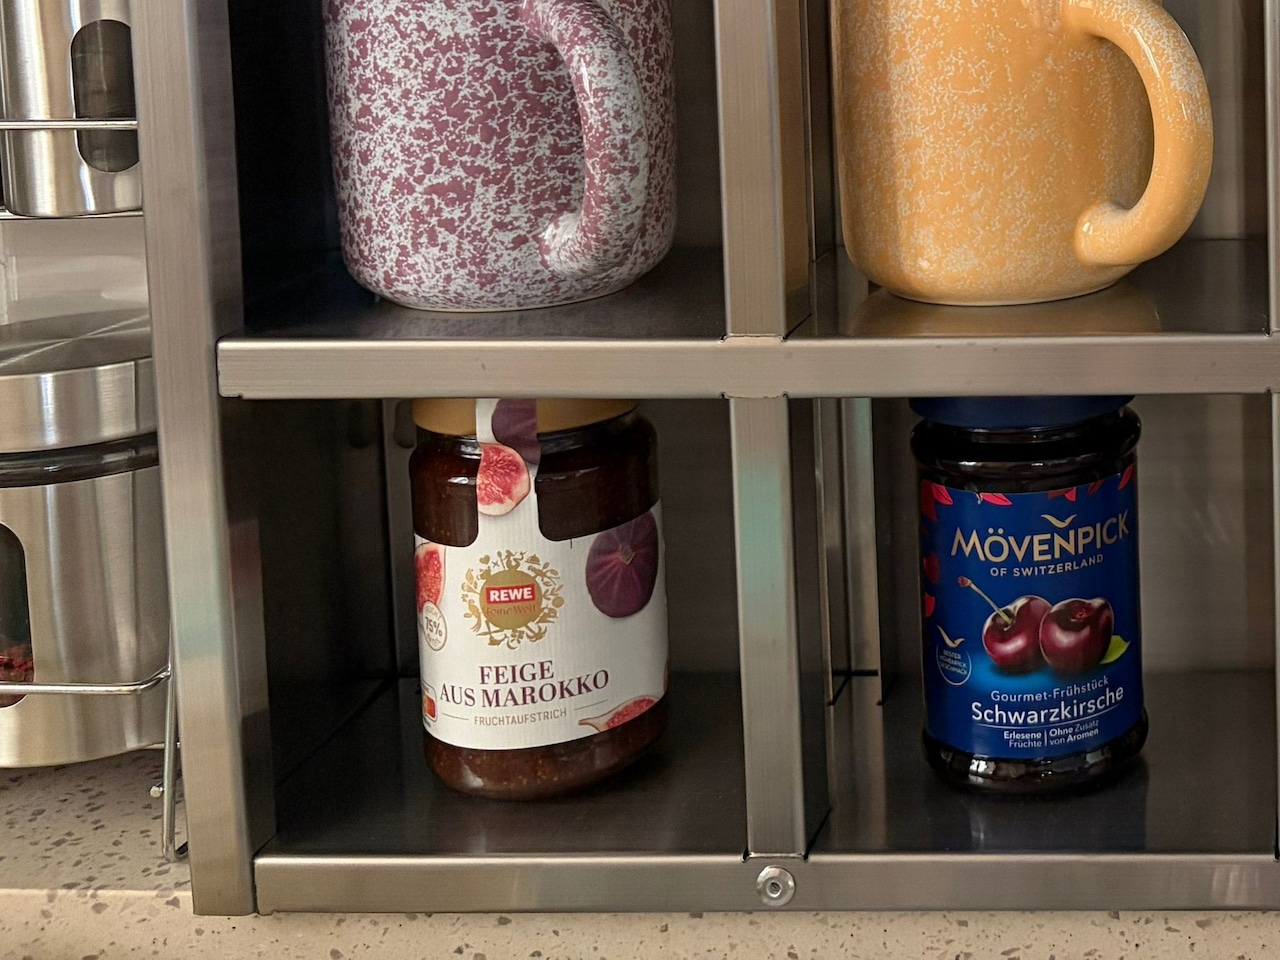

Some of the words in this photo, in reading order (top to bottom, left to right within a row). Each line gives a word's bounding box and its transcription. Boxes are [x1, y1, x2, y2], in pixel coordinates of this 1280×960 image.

[951, 509, 1129, 563] MÖVENPICK
[990, 566, 1008, 578] OF
[1013, 554, 1104, 577] SWITZERLAND
[490, 587, 534, 602] REWE
[425, 616, 443, 637] 75%
[479, 660, 555, 686] FEIGE
[440, 682, 476, 708] AUS
[481, 669, 609, 708] MAROKKO
[990, 676, 1109, 702] Gourmet-Frühstück
[971, 685, 1124, 724] Schwarzkirsche
[474, 708, 567, 726] FRUCHTAUFSTRICH
[1003, 730, 1042, 740] Erlesene
[1049, 727, 1074, 738] Ohne
[1075, 720, 1100, 733] Zusatz
[1049, 737, 1066, 746] von
[1066, 727, 1099, 743] Aromen
[1009, 739, 1043, 748] Früchte
